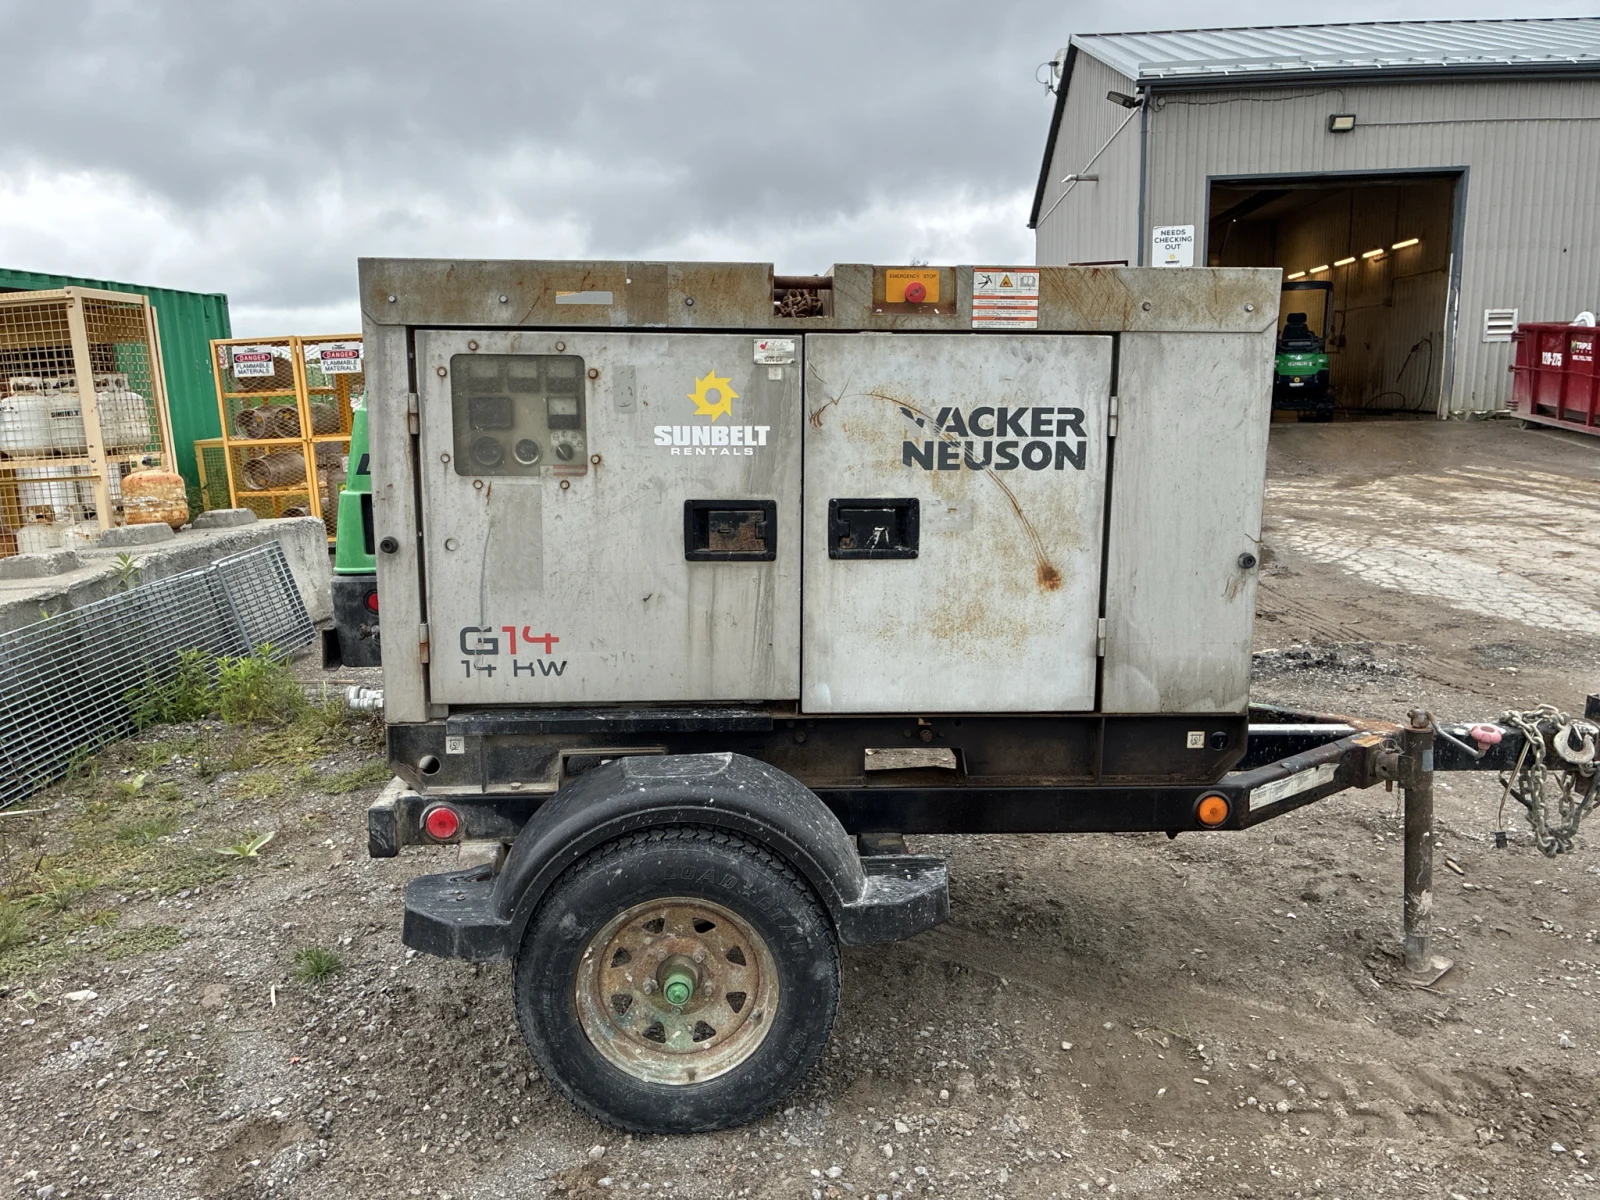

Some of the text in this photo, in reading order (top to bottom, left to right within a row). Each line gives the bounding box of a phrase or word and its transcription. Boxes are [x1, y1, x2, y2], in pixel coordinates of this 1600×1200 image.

[1160, 229, 1187, 237] NEEDS
[1154, 236, 1193, 244] CHECKING
[1164, 243, 1181, 251] OUT
[239, 353, 267, 361] DANGER
[326, 351, 354, 359] DANGER
[237, 367, 270, 375] MATERIALS
[324, 364, 357, 372] MATERIALS
[654, 425, 770, 446] SUNBELT
[670, 447, 754, 456] RENTALS
[902, 440, 1087, 471] NEUSON
[460, 625, 560, 656] G14
[460, 659, 497, 678] 14
